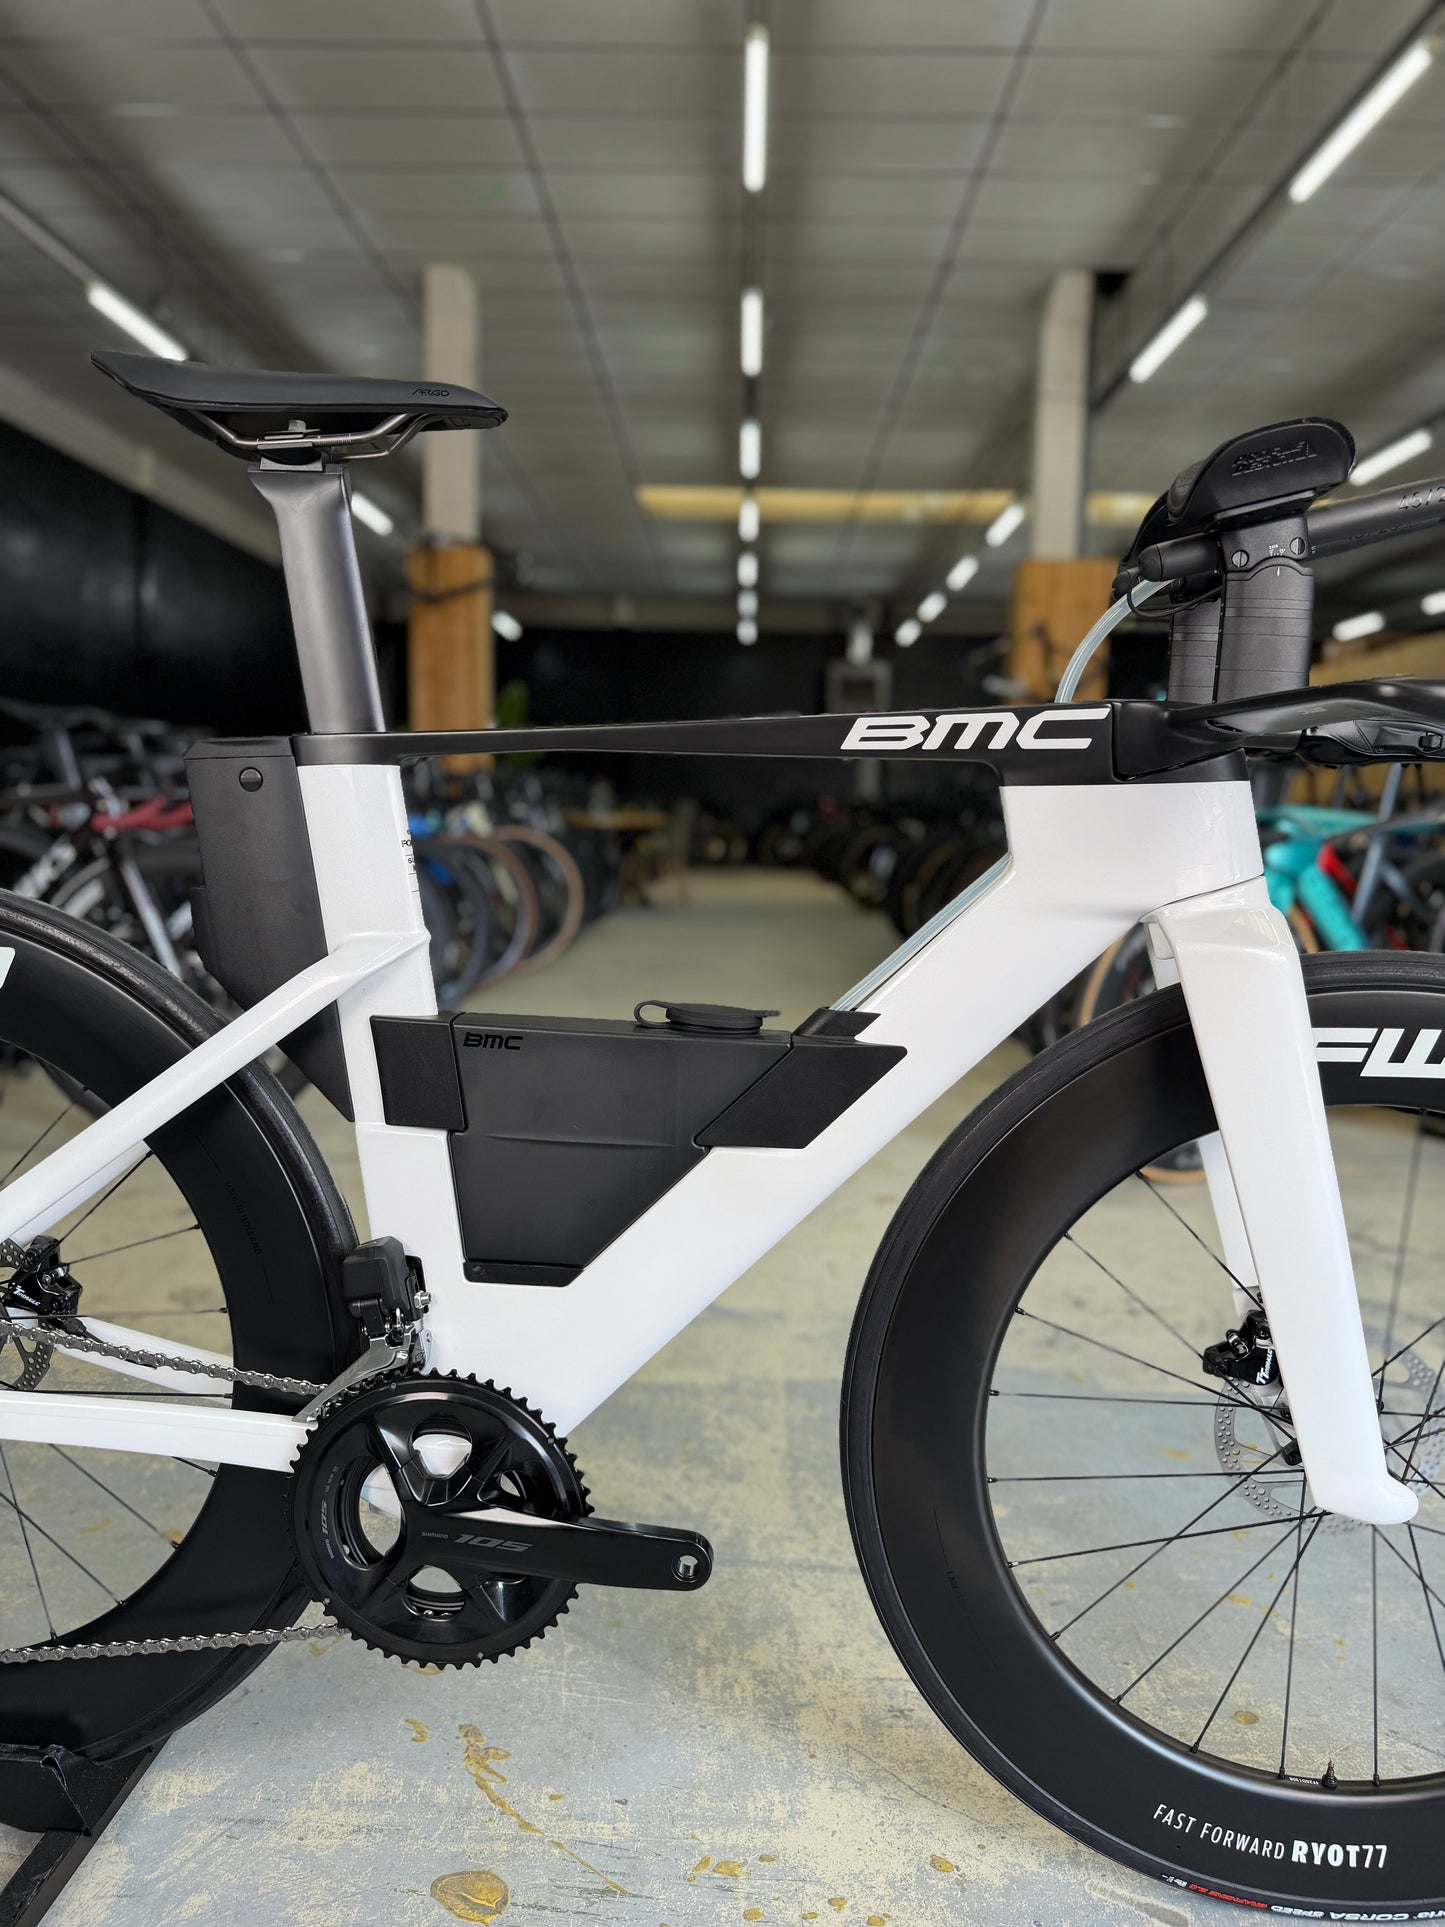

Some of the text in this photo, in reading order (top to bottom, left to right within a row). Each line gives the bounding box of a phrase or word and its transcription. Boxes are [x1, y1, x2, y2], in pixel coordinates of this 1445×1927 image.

[412, 388, 450, 397] ARGO
[840, 708, 1111, 750] BMC
[463, 1031, 523, 1051] BMC
[421, 1531, 534, 1552] SHIMANO 105
[1153, 1803, 1388, 1868] FAST FORWARD RYOT77
[1329, 1911, 1410, 1921] CORSA
